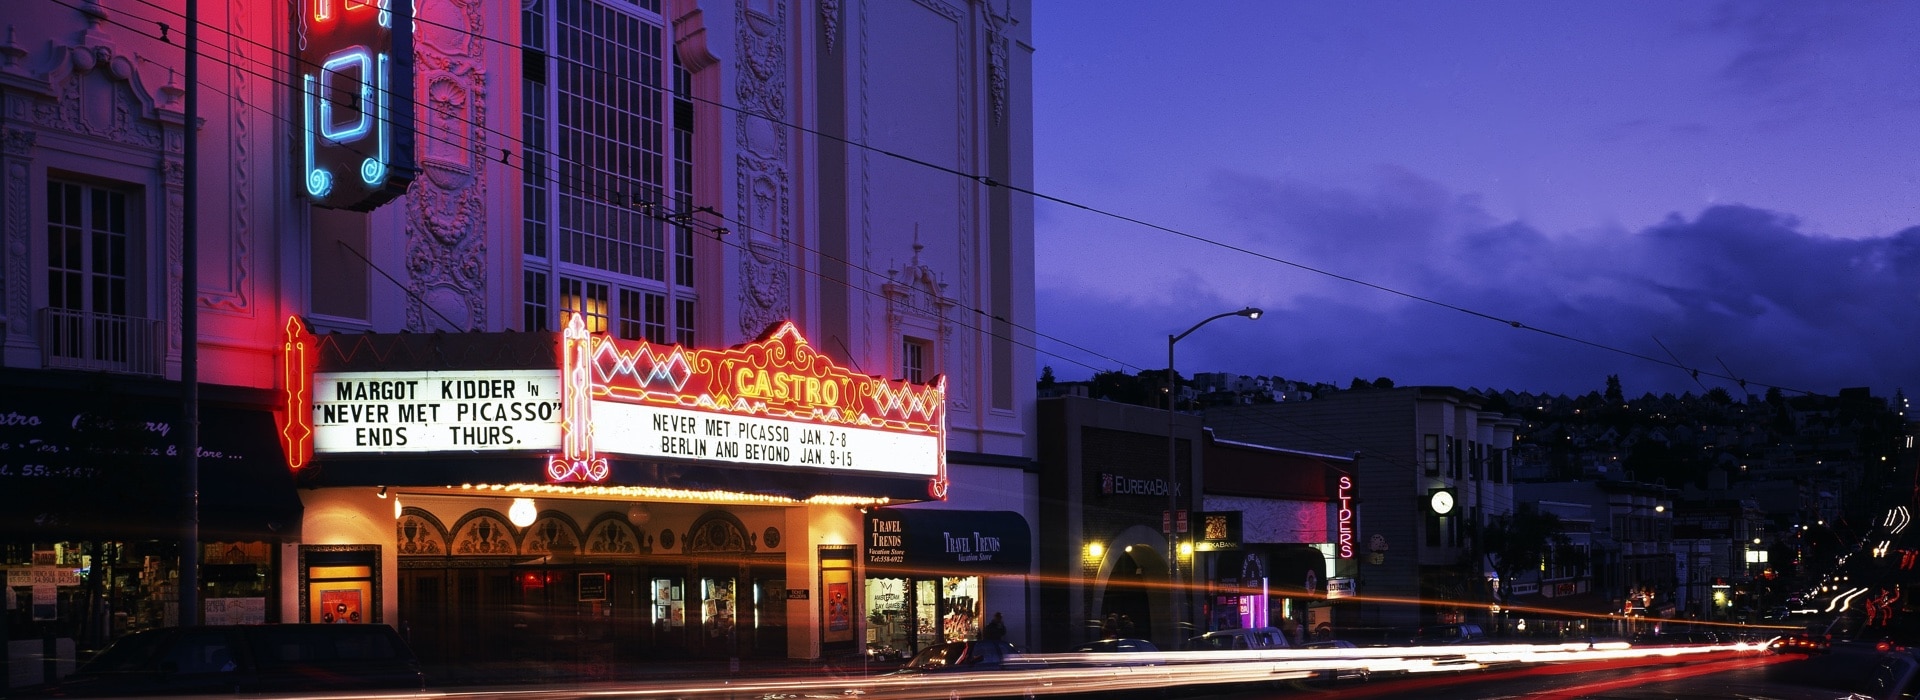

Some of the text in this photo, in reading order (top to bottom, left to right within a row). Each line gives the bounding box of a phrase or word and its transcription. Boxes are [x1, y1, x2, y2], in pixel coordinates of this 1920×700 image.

[337, 381, 418, 401] MARGOT
[441, 380, 515, 400] KIDDER
[736, 367, 839, 406] CASTRO
[399, 403, 440, 423] MET
[356, 425, 522, 446] ENDS THURS.
[652, 413, 847, 448] NEVER MET PICASSO JAN. 2-8
[661, 435, 853, 467] BERLIN AND BEYOND JAN. 9-15
[872, 518, 902, 533] TRAVEL
[1338, 475, 1353, 559] SLIDERS
[872, 532, 902, 547] TRENDS
[943, 531, 1001, 553] TRAVEL TRENDS
[892, 548, 905, 556] Store
[958, 553, 992, 562] Vacation Store
